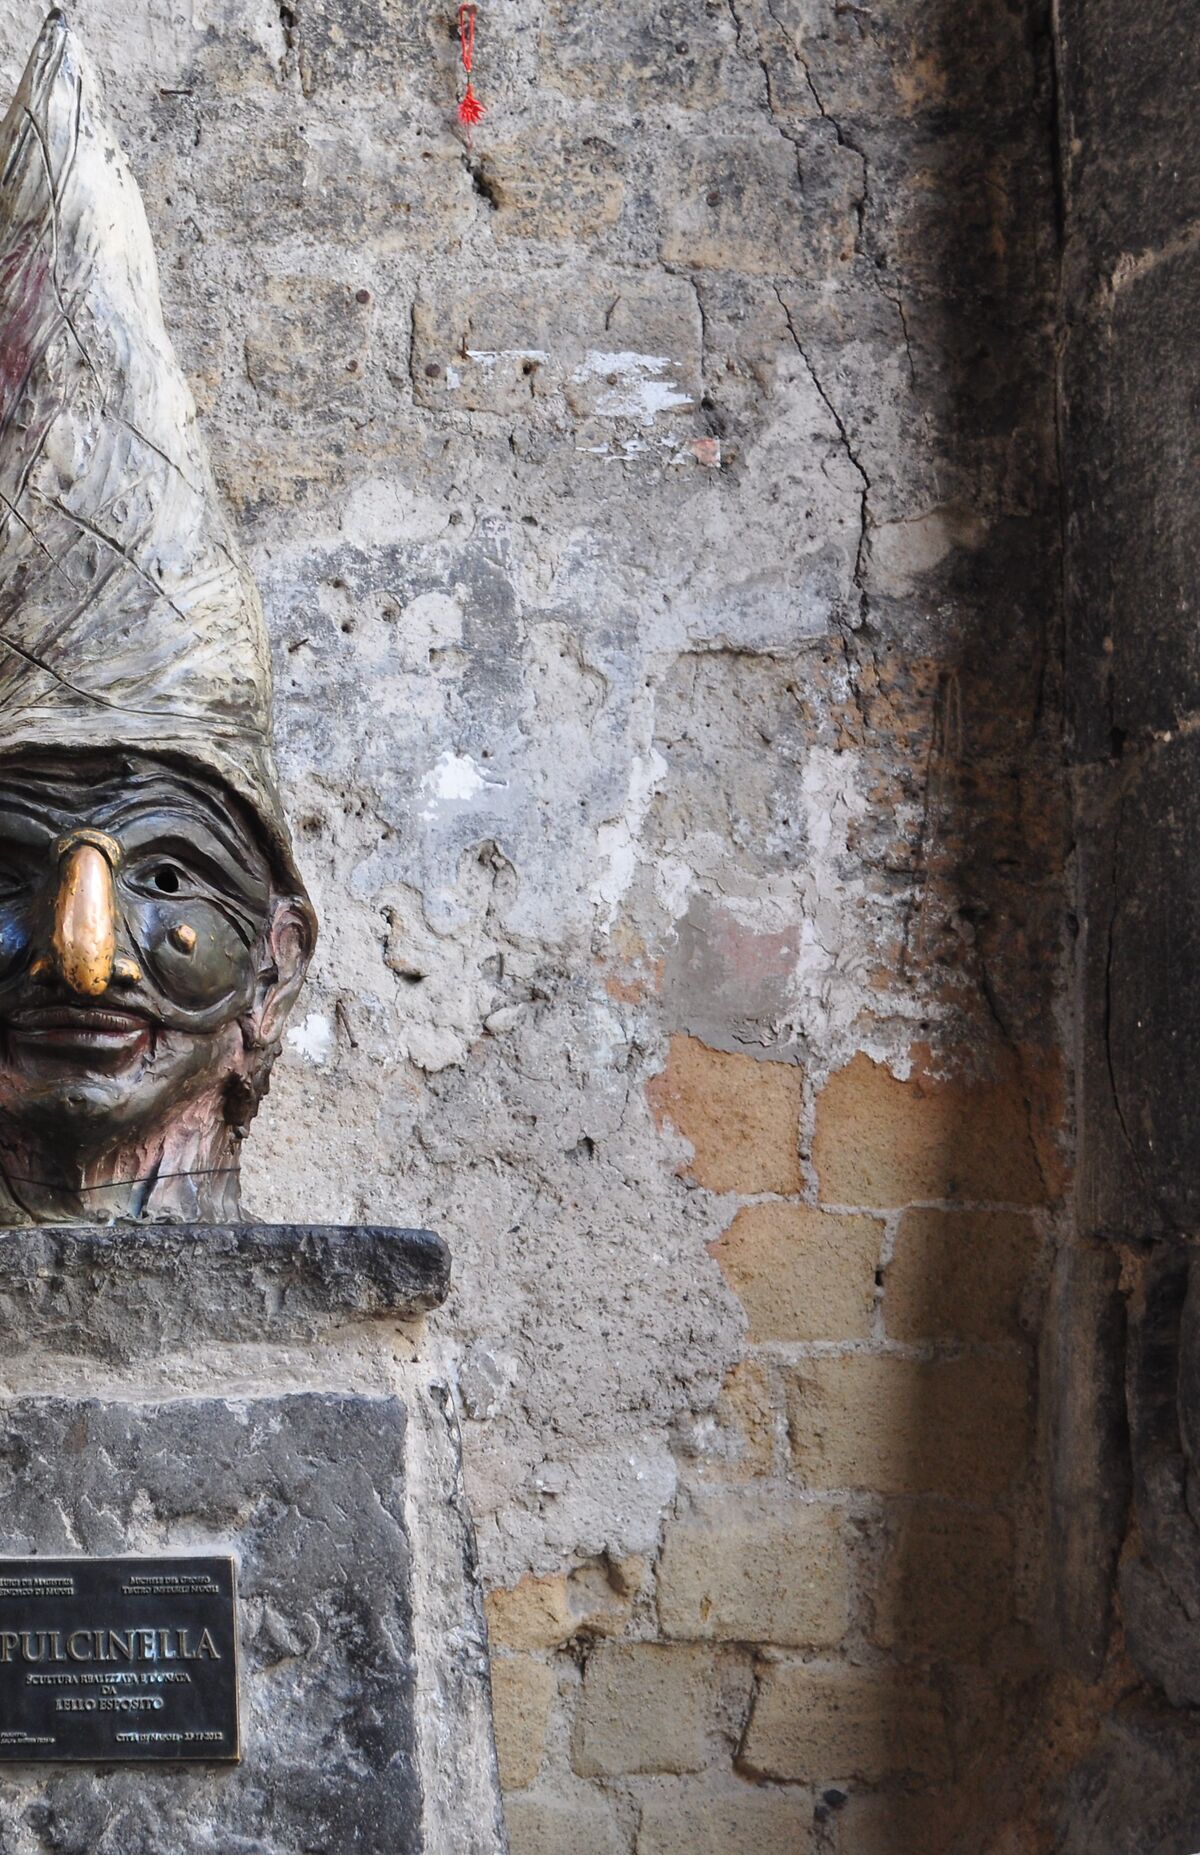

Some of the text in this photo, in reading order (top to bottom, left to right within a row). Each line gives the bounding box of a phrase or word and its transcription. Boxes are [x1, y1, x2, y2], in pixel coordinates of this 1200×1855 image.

[0, 1627, 221, 1662] PULCINELLA
[26, 1673, 78, 1685] SCULTURA
[101, 1685, 117, 1695] DA
[100, 1696, 165, 1711] ESPOSITO
